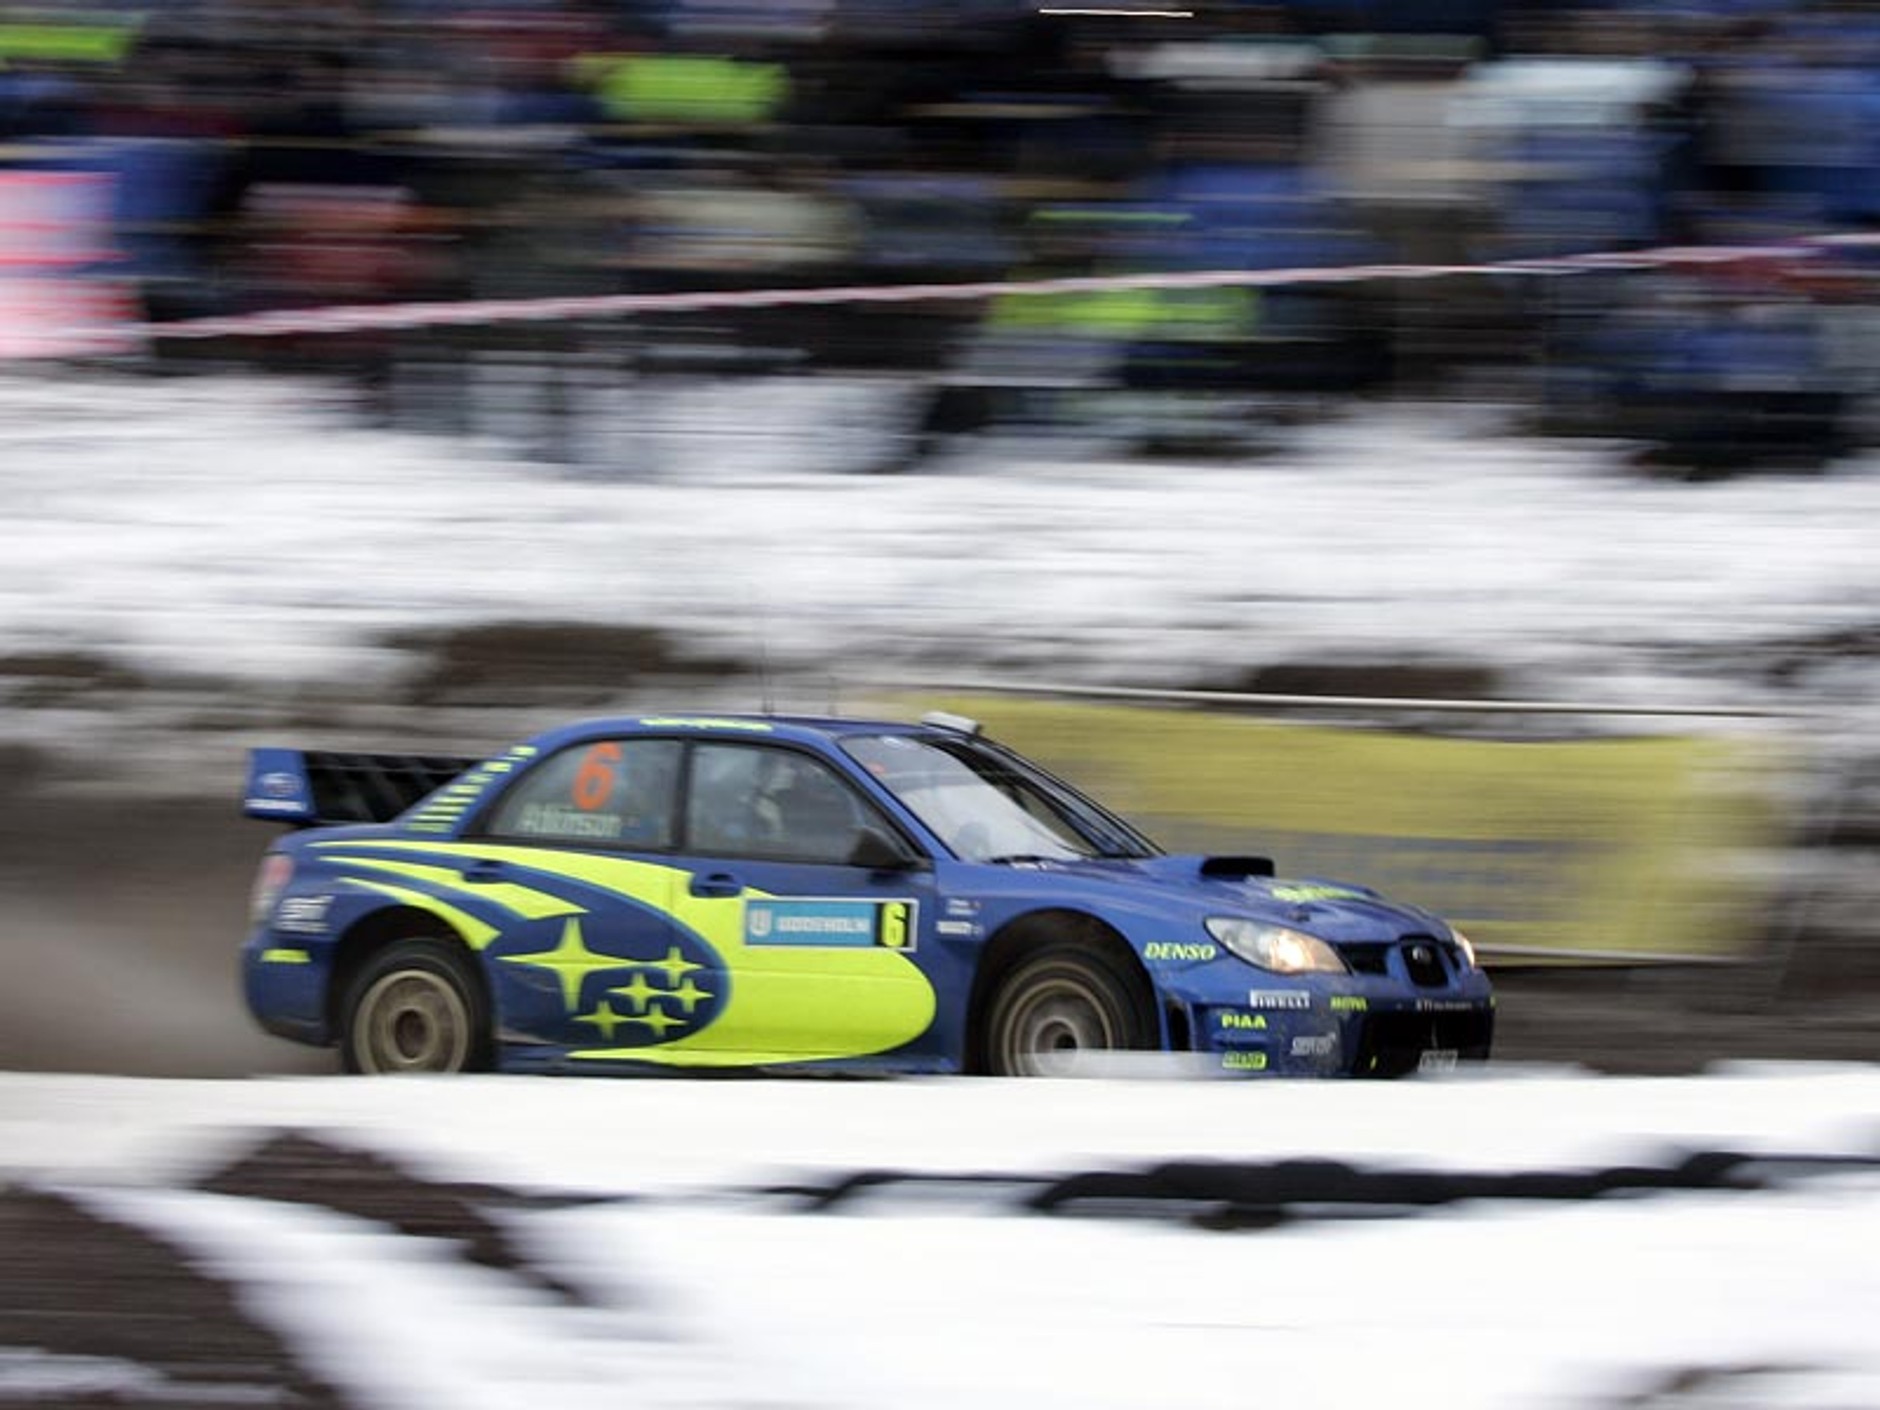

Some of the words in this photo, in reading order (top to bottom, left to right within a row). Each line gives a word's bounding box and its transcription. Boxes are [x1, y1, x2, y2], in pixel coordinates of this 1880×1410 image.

[572, 741, 624, 812] 6
[882, 902, 906, 947] 6
[1144, 942, 1216, 961] DENSO
[1222, 1014, 1267, 1029] PIAA
